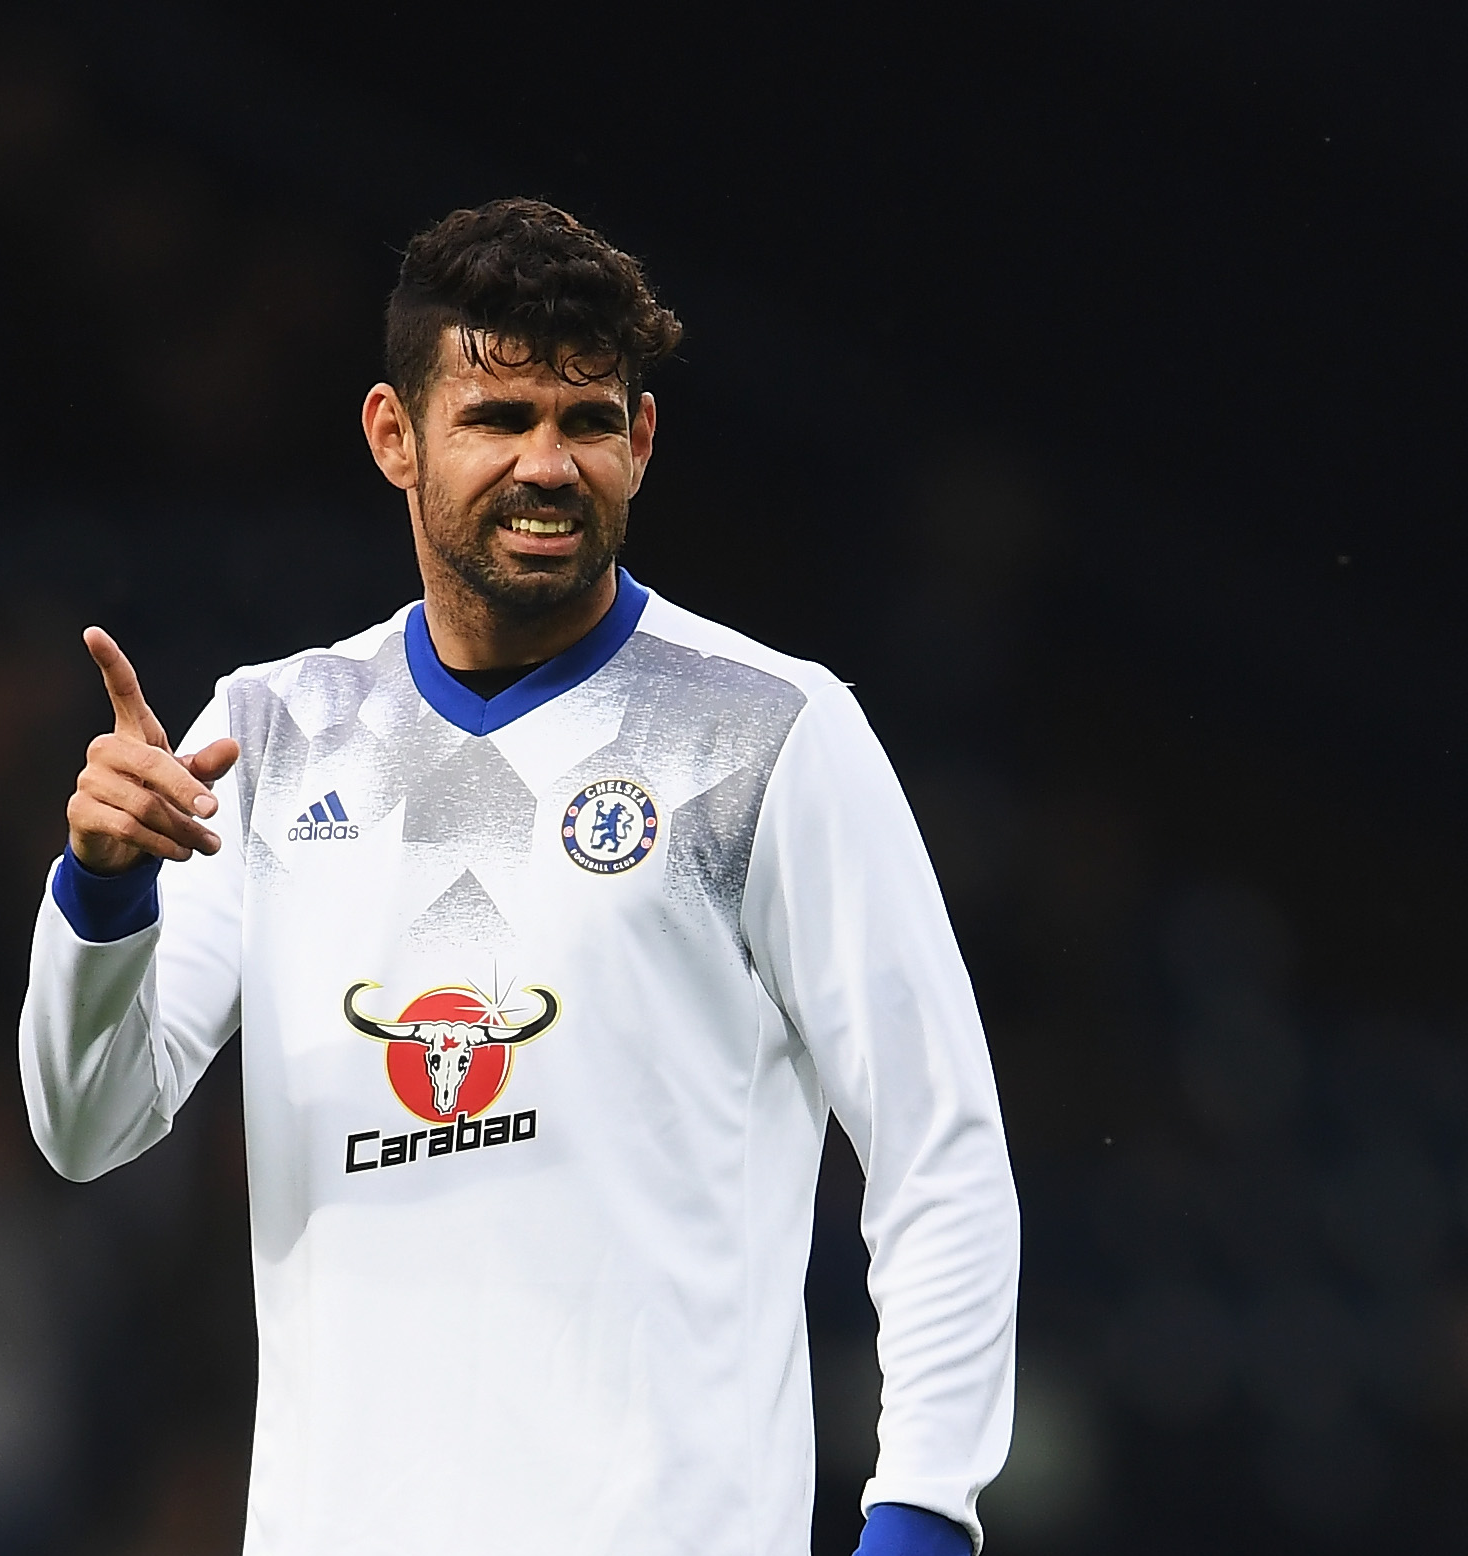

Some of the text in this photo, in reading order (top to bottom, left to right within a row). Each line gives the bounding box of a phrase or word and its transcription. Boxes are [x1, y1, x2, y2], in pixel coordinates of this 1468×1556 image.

[584, 781, 648, 808] CHELSEA
[287, 821, 360, 842] adidas
[569, 848, 636, 872] FOOTBALL CLUB
[345, 1108, 537, 1174] Carabao
